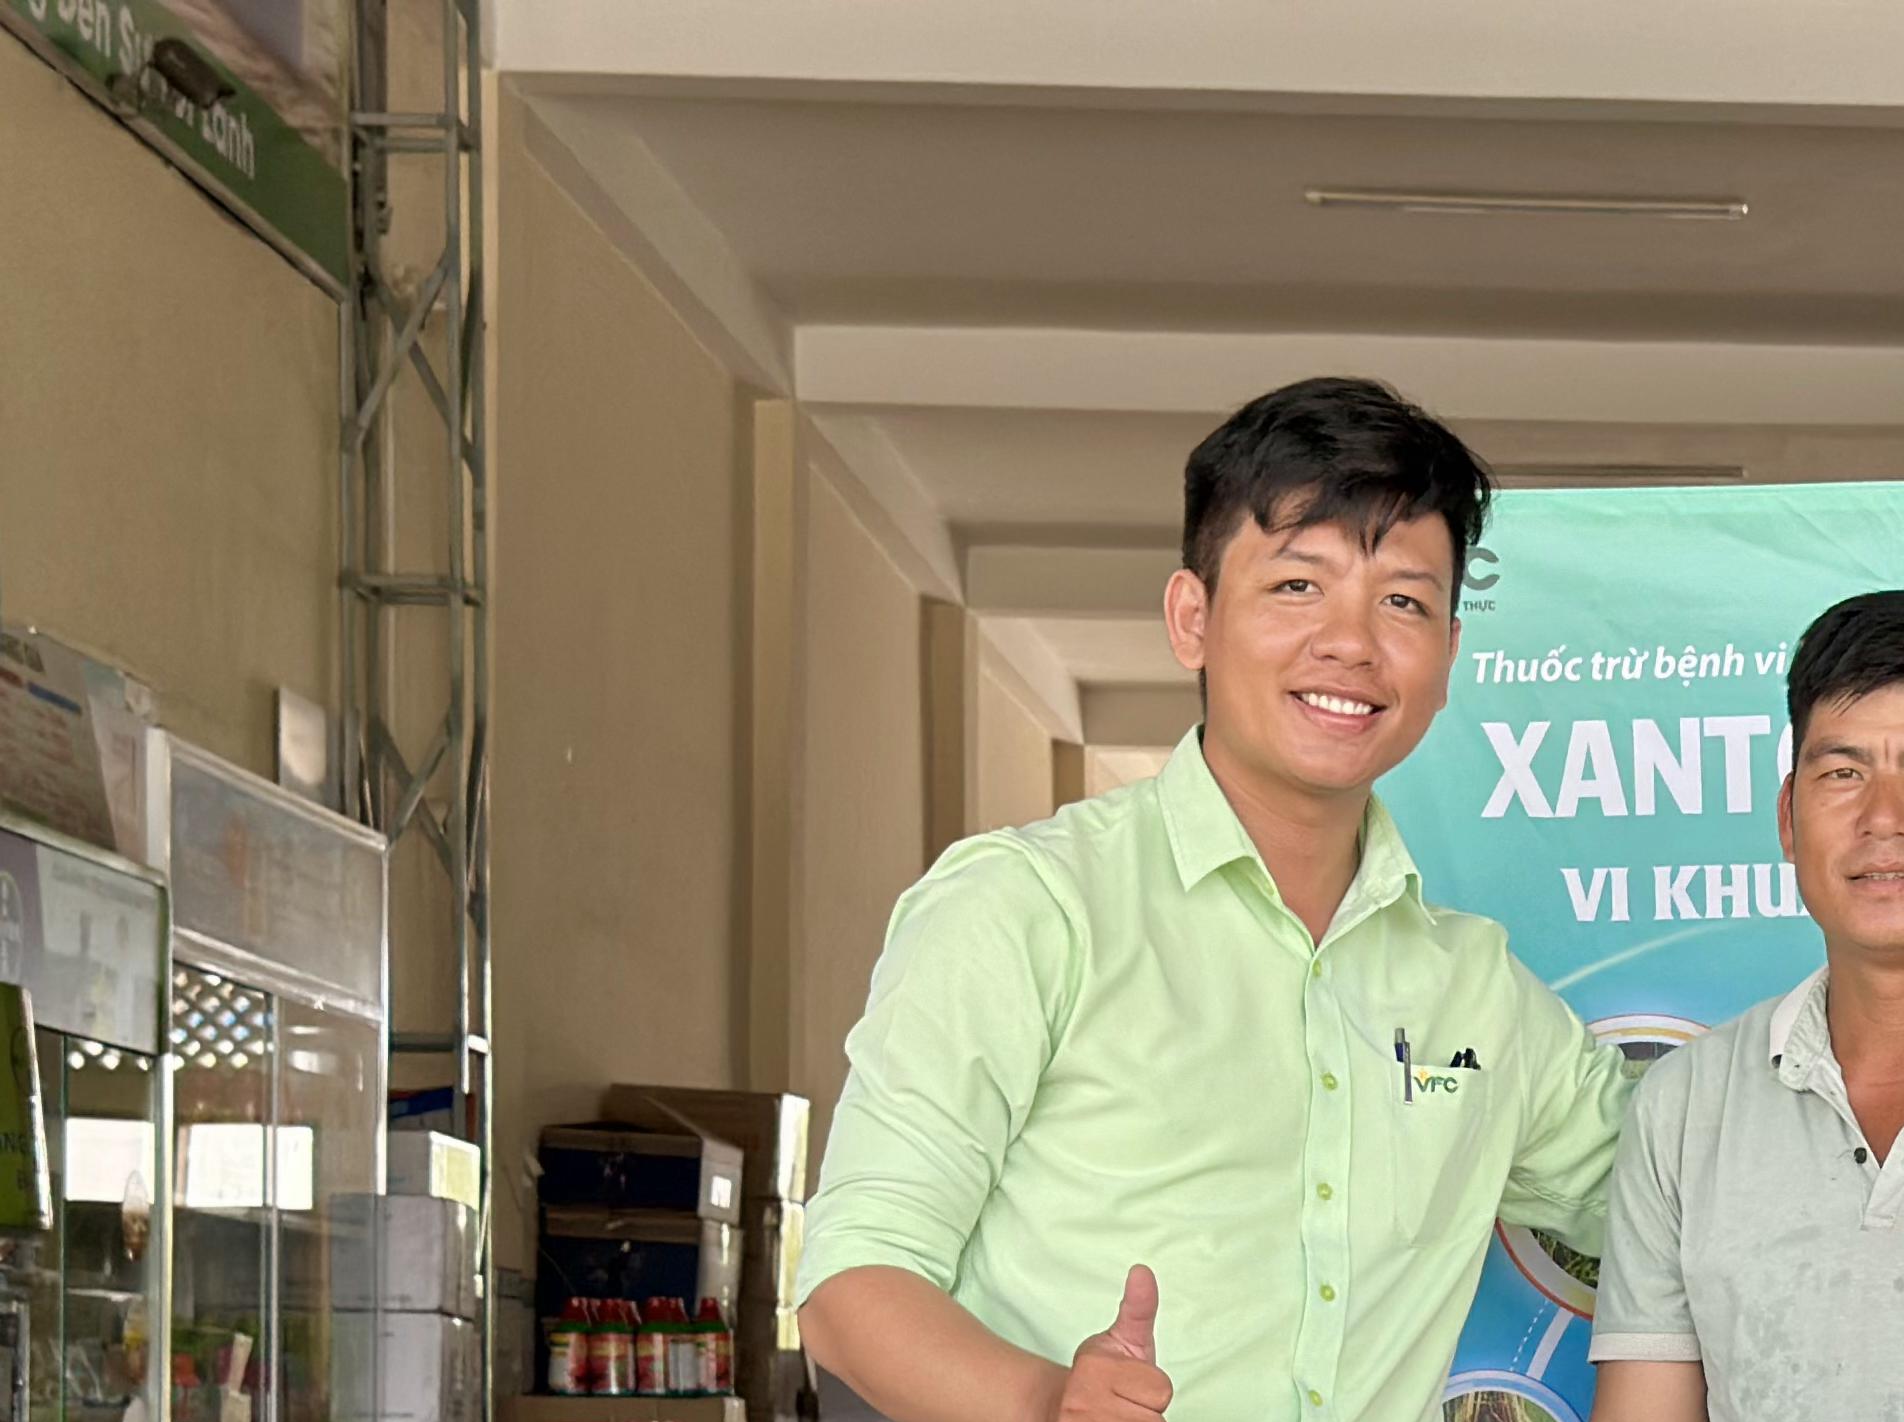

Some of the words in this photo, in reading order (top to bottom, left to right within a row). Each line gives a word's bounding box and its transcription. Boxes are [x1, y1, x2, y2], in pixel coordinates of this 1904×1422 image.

[1472, 645, 1583, 684] Thuốc
[1591, 647, 1650, 681] trừ
[1654, 644, 1746, 687] bệnh
[1754, 642, 1788, 676] vi
[1559, 867, 1632, 922] VI
[1652, 862, 1811, 922] KHU
[1413, 1076, 1459, 1094] VFC
